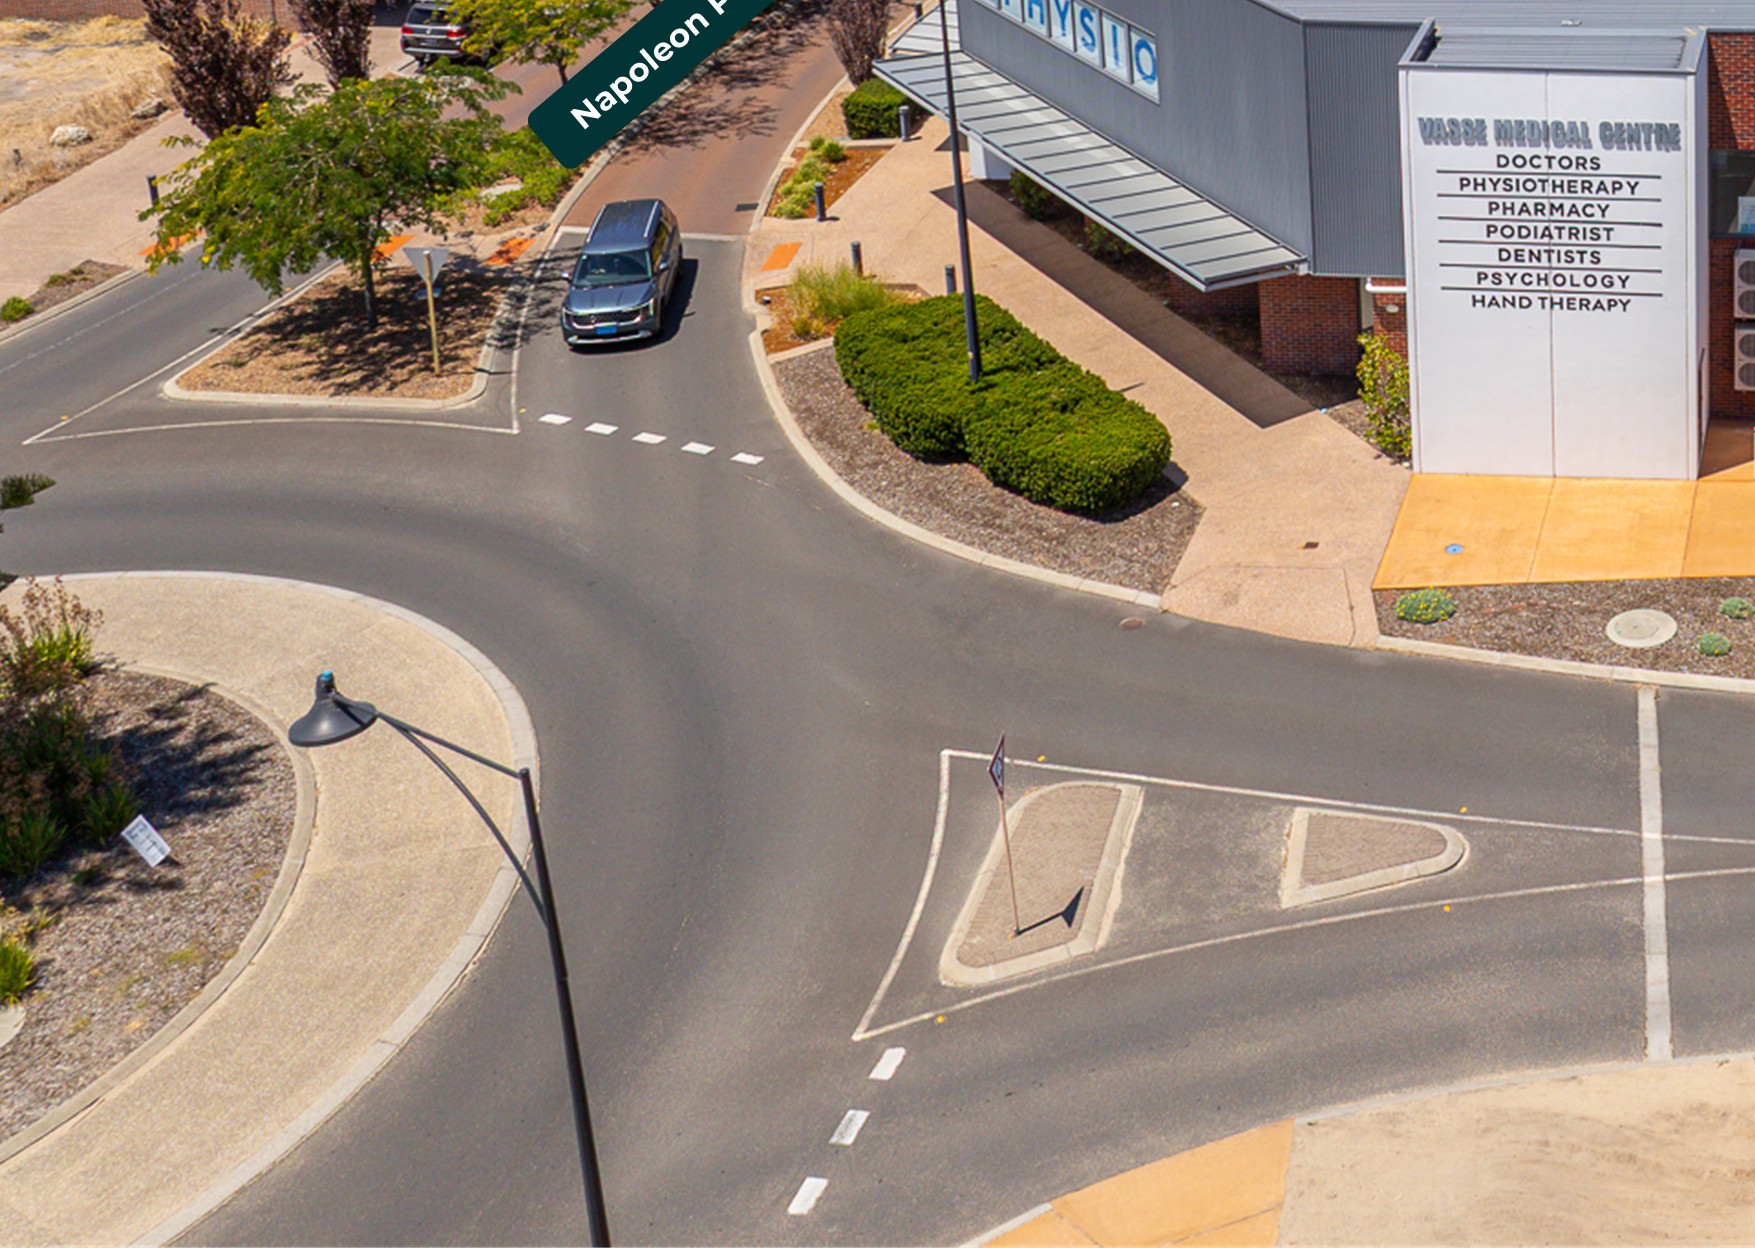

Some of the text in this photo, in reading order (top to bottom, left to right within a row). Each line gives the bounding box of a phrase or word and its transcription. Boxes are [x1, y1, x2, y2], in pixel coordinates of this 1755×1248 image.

[1417, 117, 1682, 151] VASSE MEDICAL CENTRE
[1496, 154, 1601, 171] DOCTORS
[1459, 177, 1640, 195] PHYSIOTHERAPY
[1488, 201, 1610, 218] PHARMACY
[1486, 224, 1615, 241] PODIATRIST
[1498, 248, 1601, 264] DENTISTS
[1477, 271, 1631, 289] PSYCHOLOGY
[1472, 294, 1632, 312] HAND THERAPY
